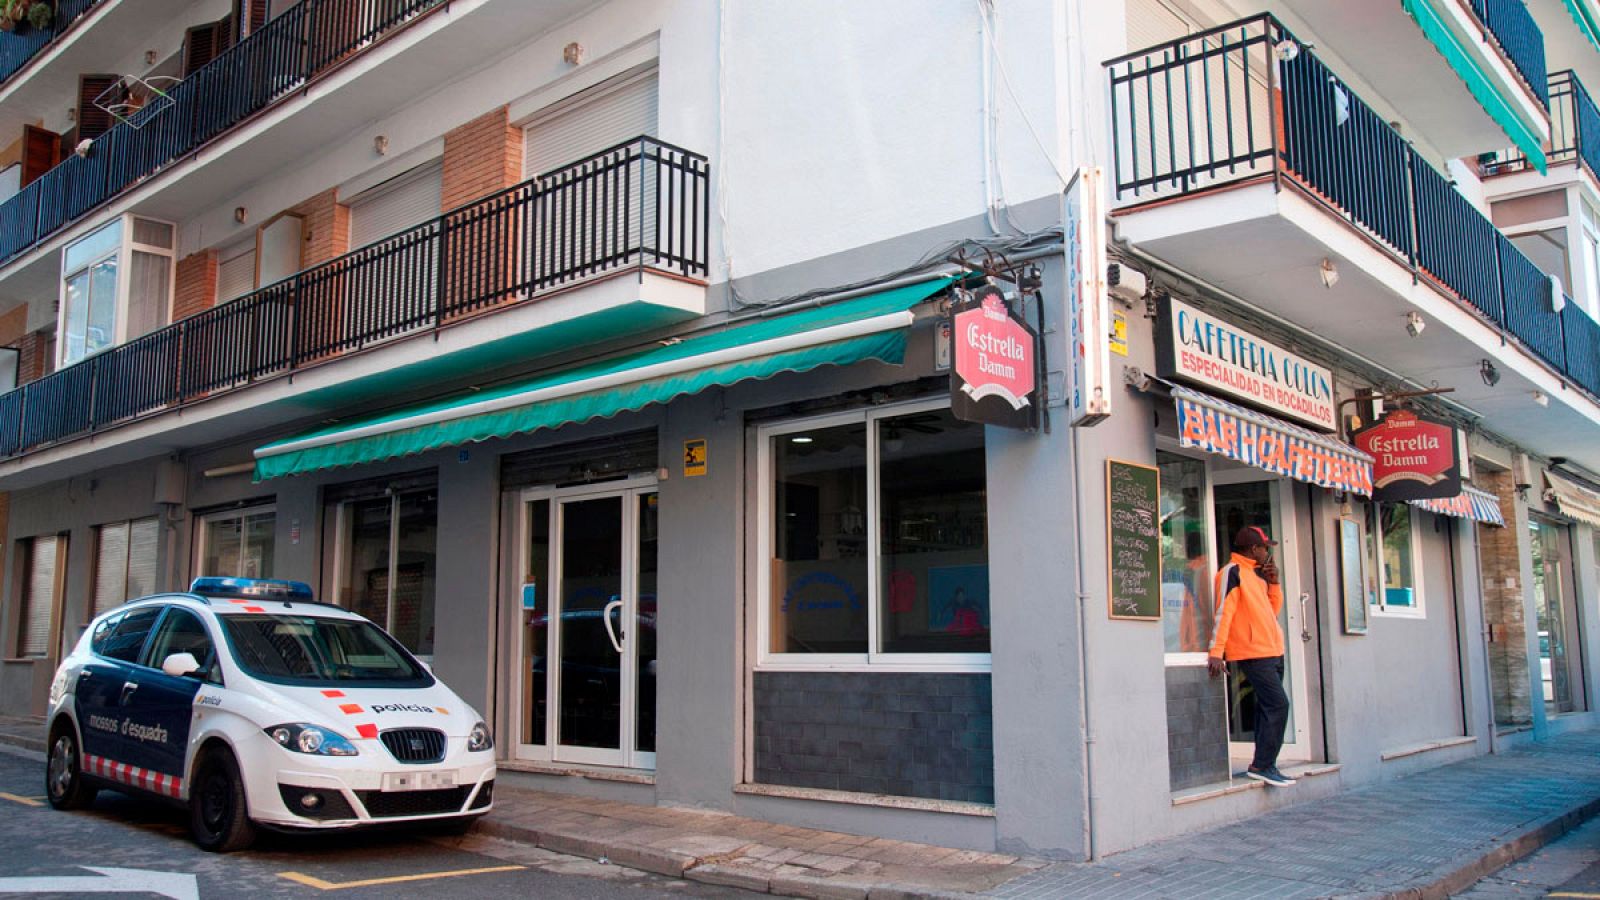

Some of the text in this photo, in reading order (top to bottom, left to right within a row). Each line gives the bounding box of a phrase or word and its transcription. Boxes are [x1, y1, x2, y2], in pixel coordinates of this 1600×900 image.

[967, 322, 1024, 361] Estrella
[1178, 310, 1330, 401] CAFETERIA COLON
[979, 352, 1016, 380] Damm
[1181, 351, 1332, 424] ESPECIALIDAD EN BOCADILLOS
[1388, 419, 1416, 429] Damm
[1369, 433, 1440, 453] Estrella
[1383, 453, 1428, 467] Damm
[371, 703, 434, 714] policia
[90, 714, 168, 744] mossos d'esquadra
